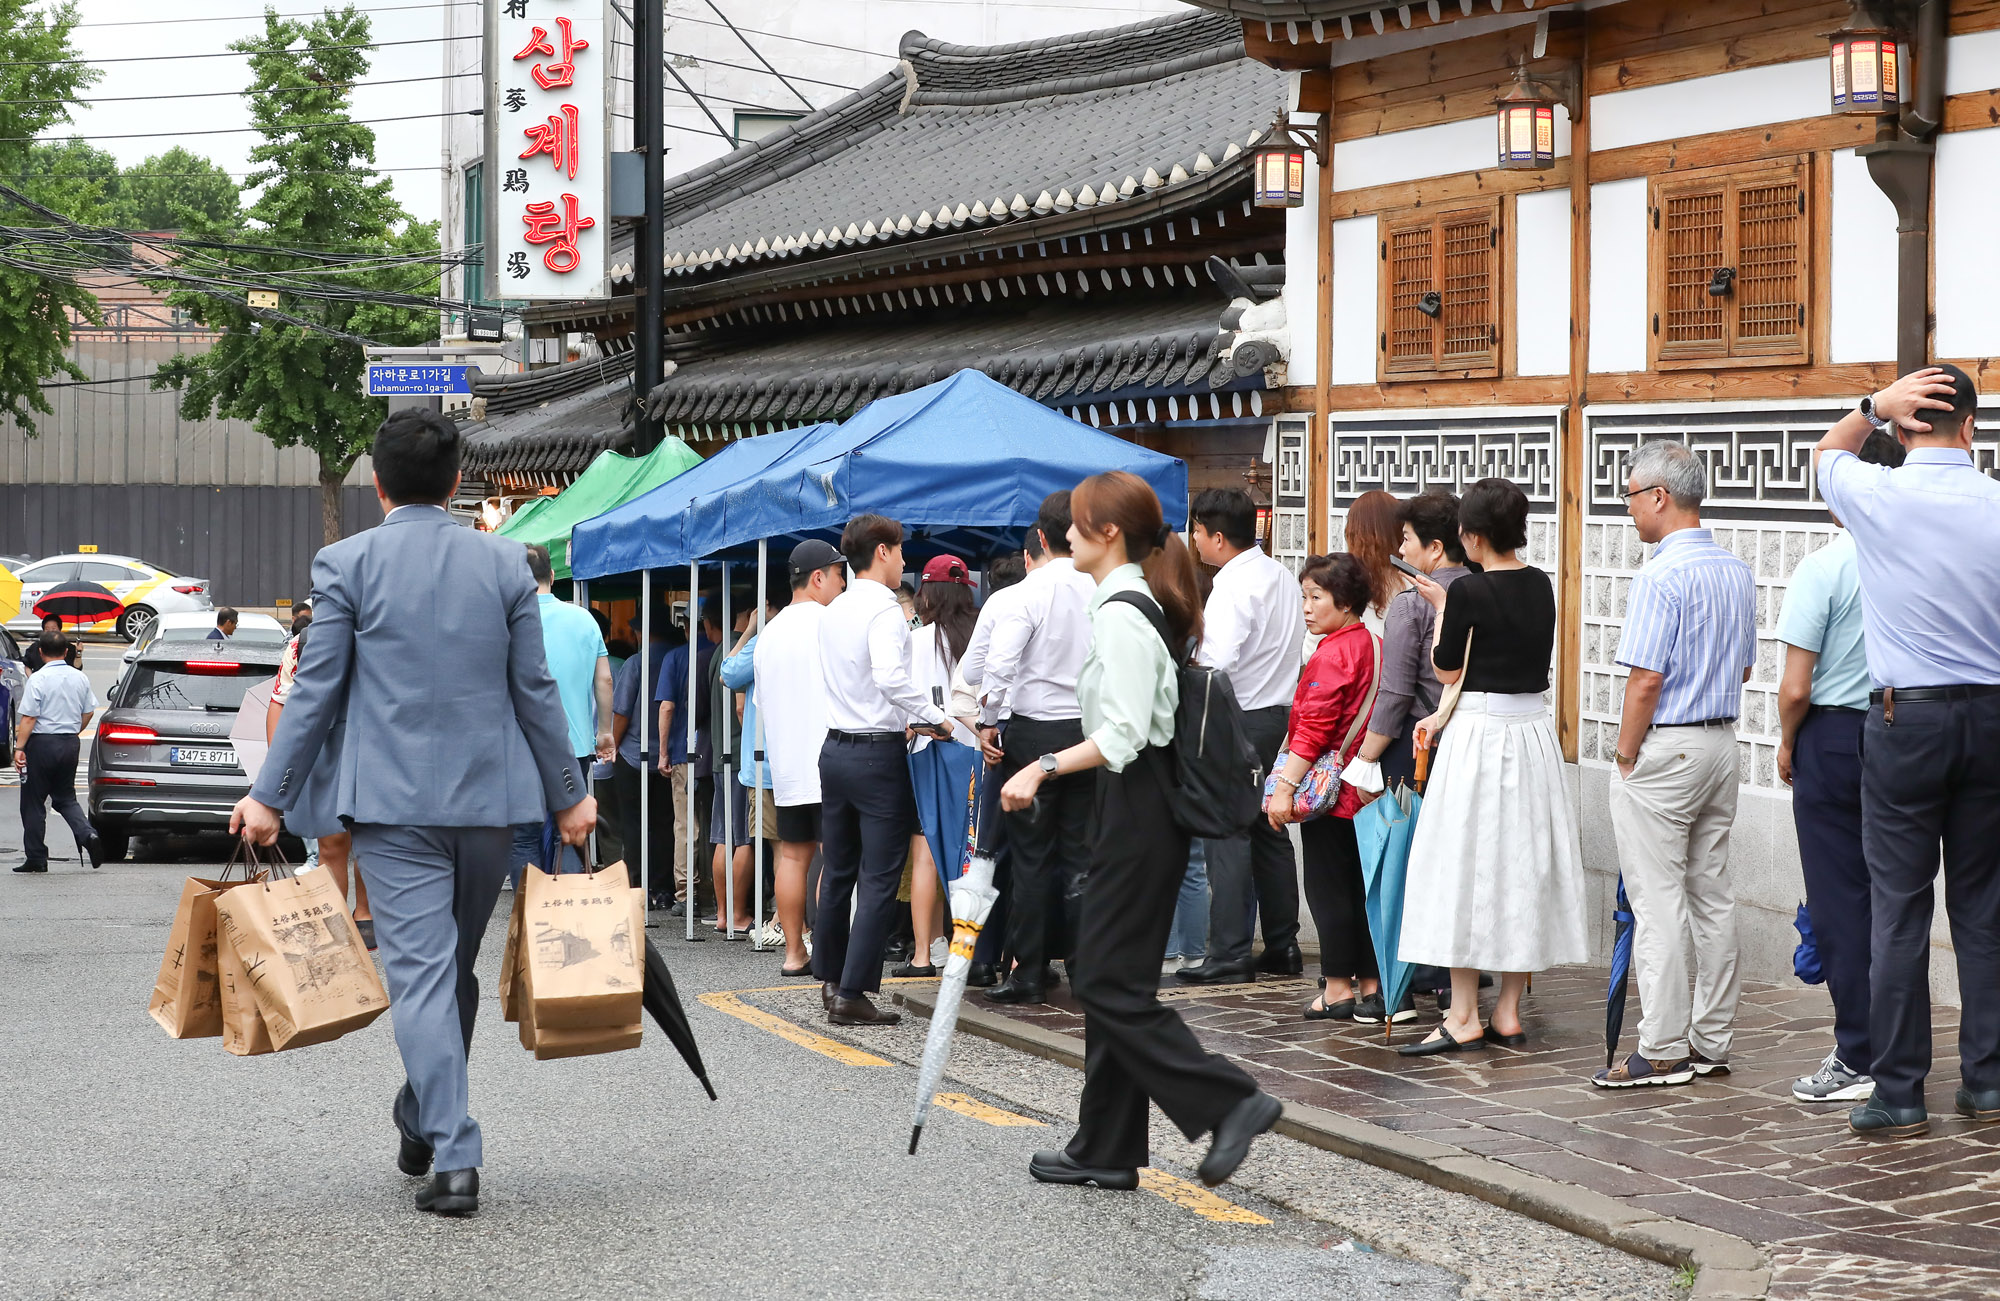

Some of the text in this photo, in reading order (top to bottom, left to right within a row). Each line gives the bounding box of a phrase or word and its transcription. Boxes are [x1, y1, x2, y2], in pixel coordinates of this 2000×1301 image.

[513, 16, 596, 274] 삼계탕
[372, 368, 452, 382] 자하문로1가길
[372, 383, 454, 393] Jahamun-ro 1ga-gil
[209, 751, 235, 763] 8711
